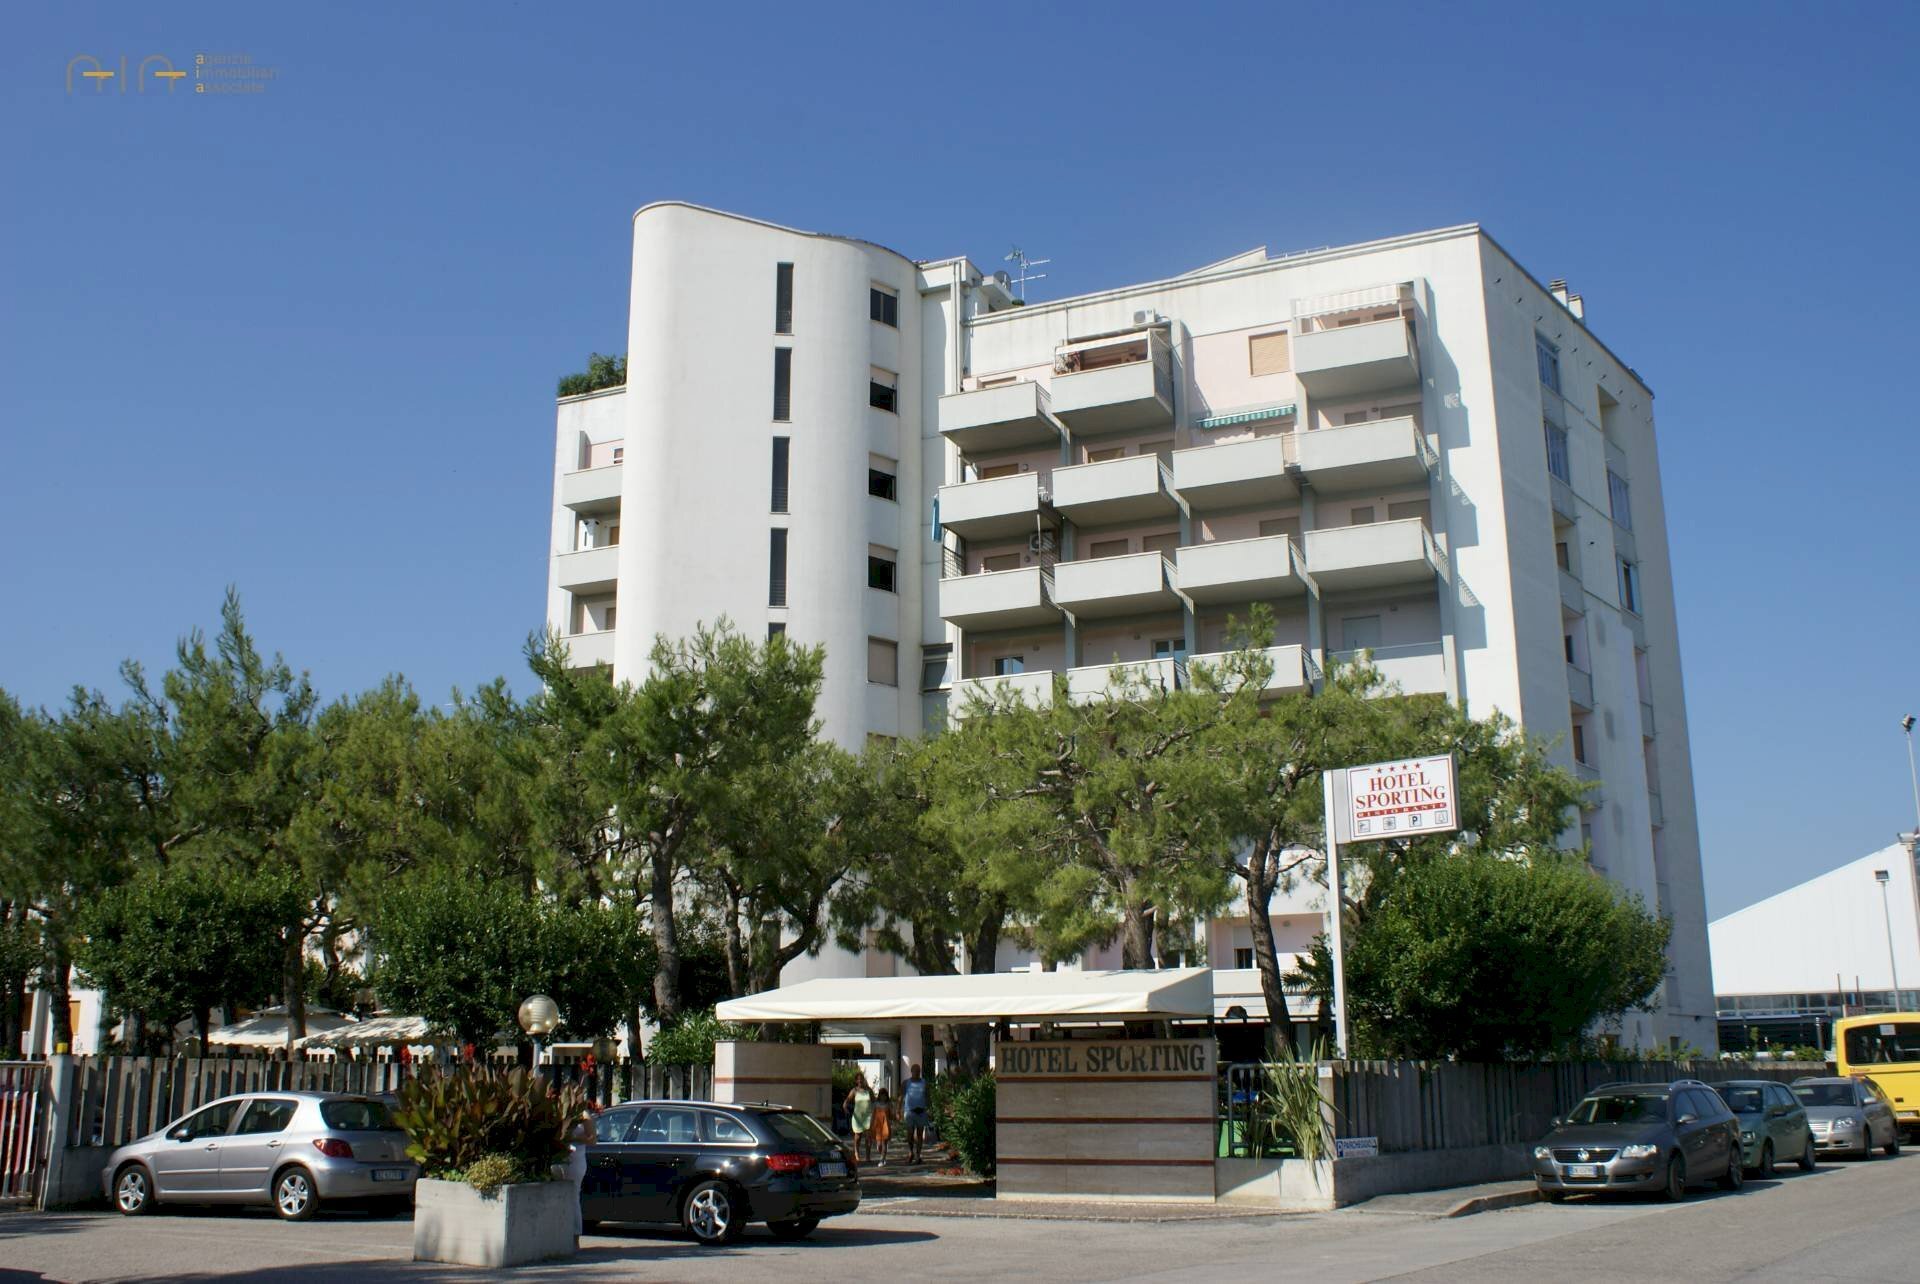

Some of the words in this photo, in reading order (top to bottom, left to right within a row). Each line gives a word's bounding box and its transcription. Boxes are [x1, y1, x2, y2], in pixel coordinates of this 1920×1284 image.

[1369, 772, 1430, 792] HOTEL
[1355, 785, 1446, 809] SPORTING
[1358, 802, 1446, 818] RISTORANTE
[1001, 1047, 1077, 1073] HOTEL
